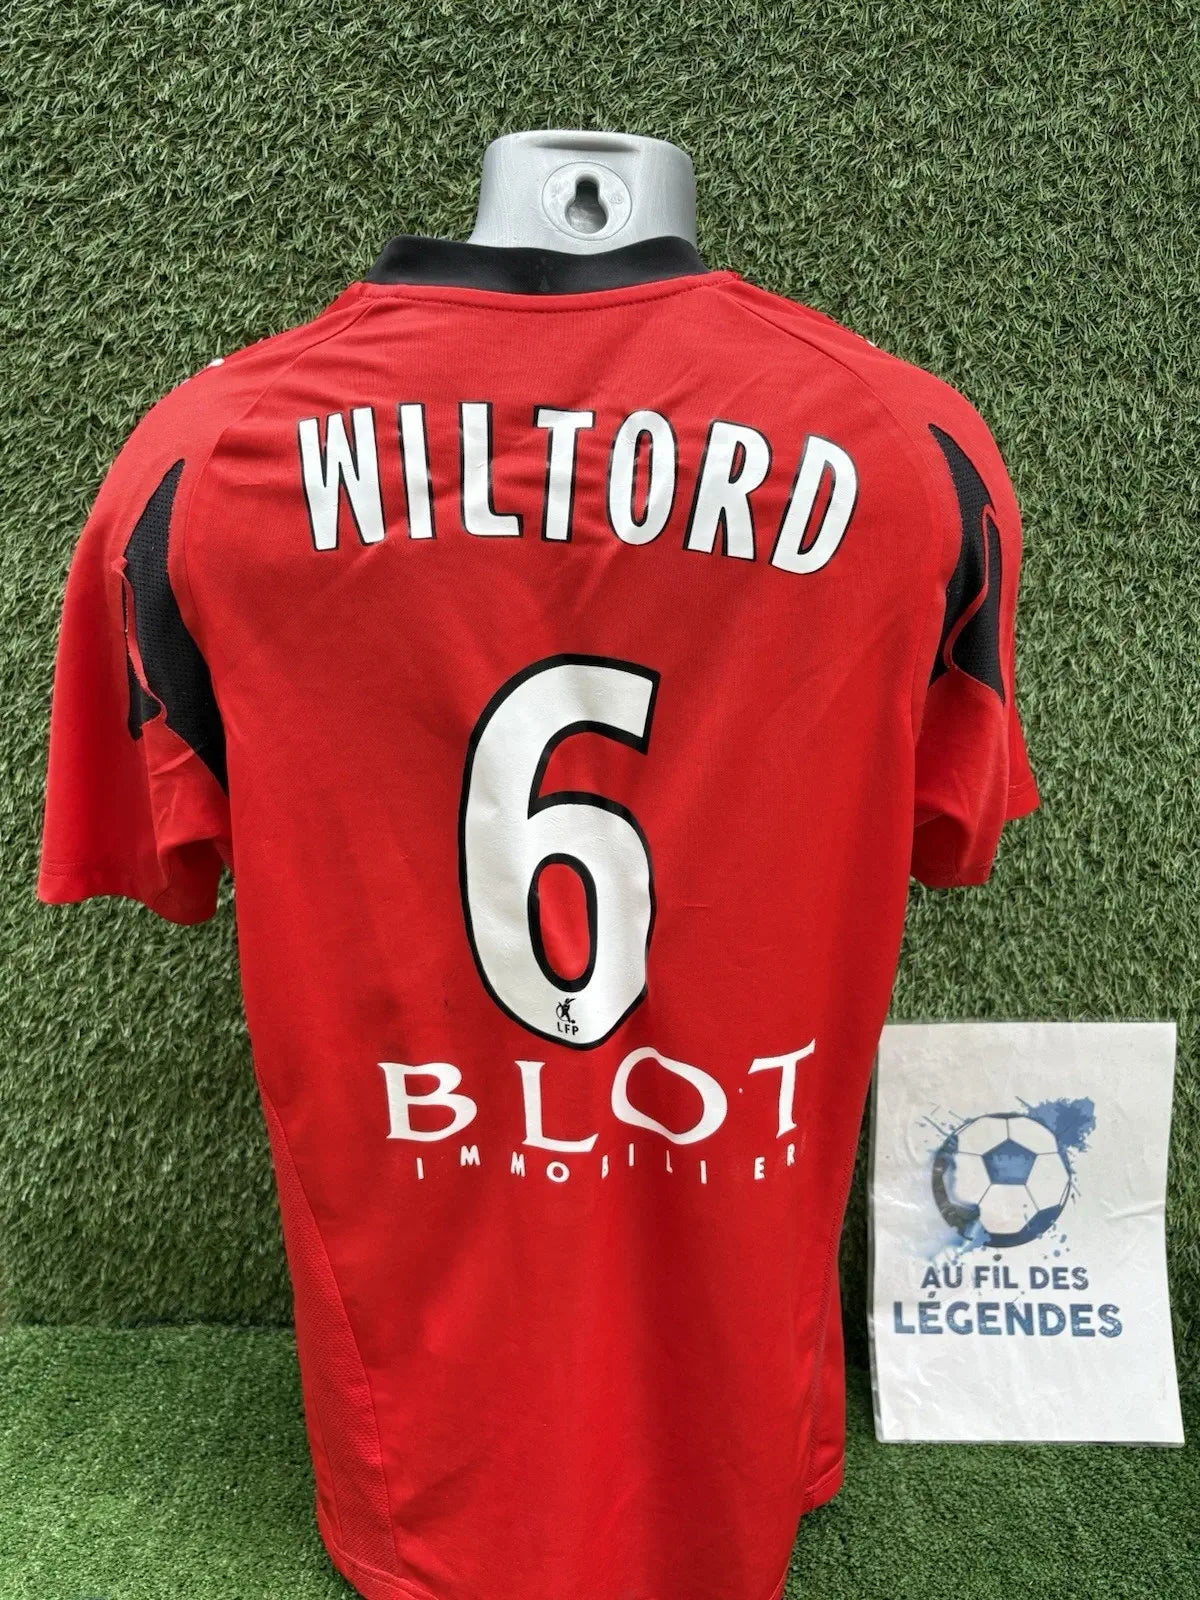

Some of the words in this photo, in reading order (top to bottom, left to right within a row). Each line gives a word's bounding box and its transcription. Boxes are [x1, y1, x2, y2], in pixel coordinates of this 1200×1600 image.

[299, 401, 859, 574] WILTORD
[458, 653, 661, 1051] 6
[557, 1021, 579, 1035] LFP
[377, 1039, 816, 1153] BLOT
[416, 1143, 796, 1185] IMMOBILIER
[921, 1265, 963, 1289] AU
[974, 1265, 1019, 1289] FIL
[1029, 1266, 1090, 1290] DES
[893, 1291, 1124, 1338] LÉGENDES
